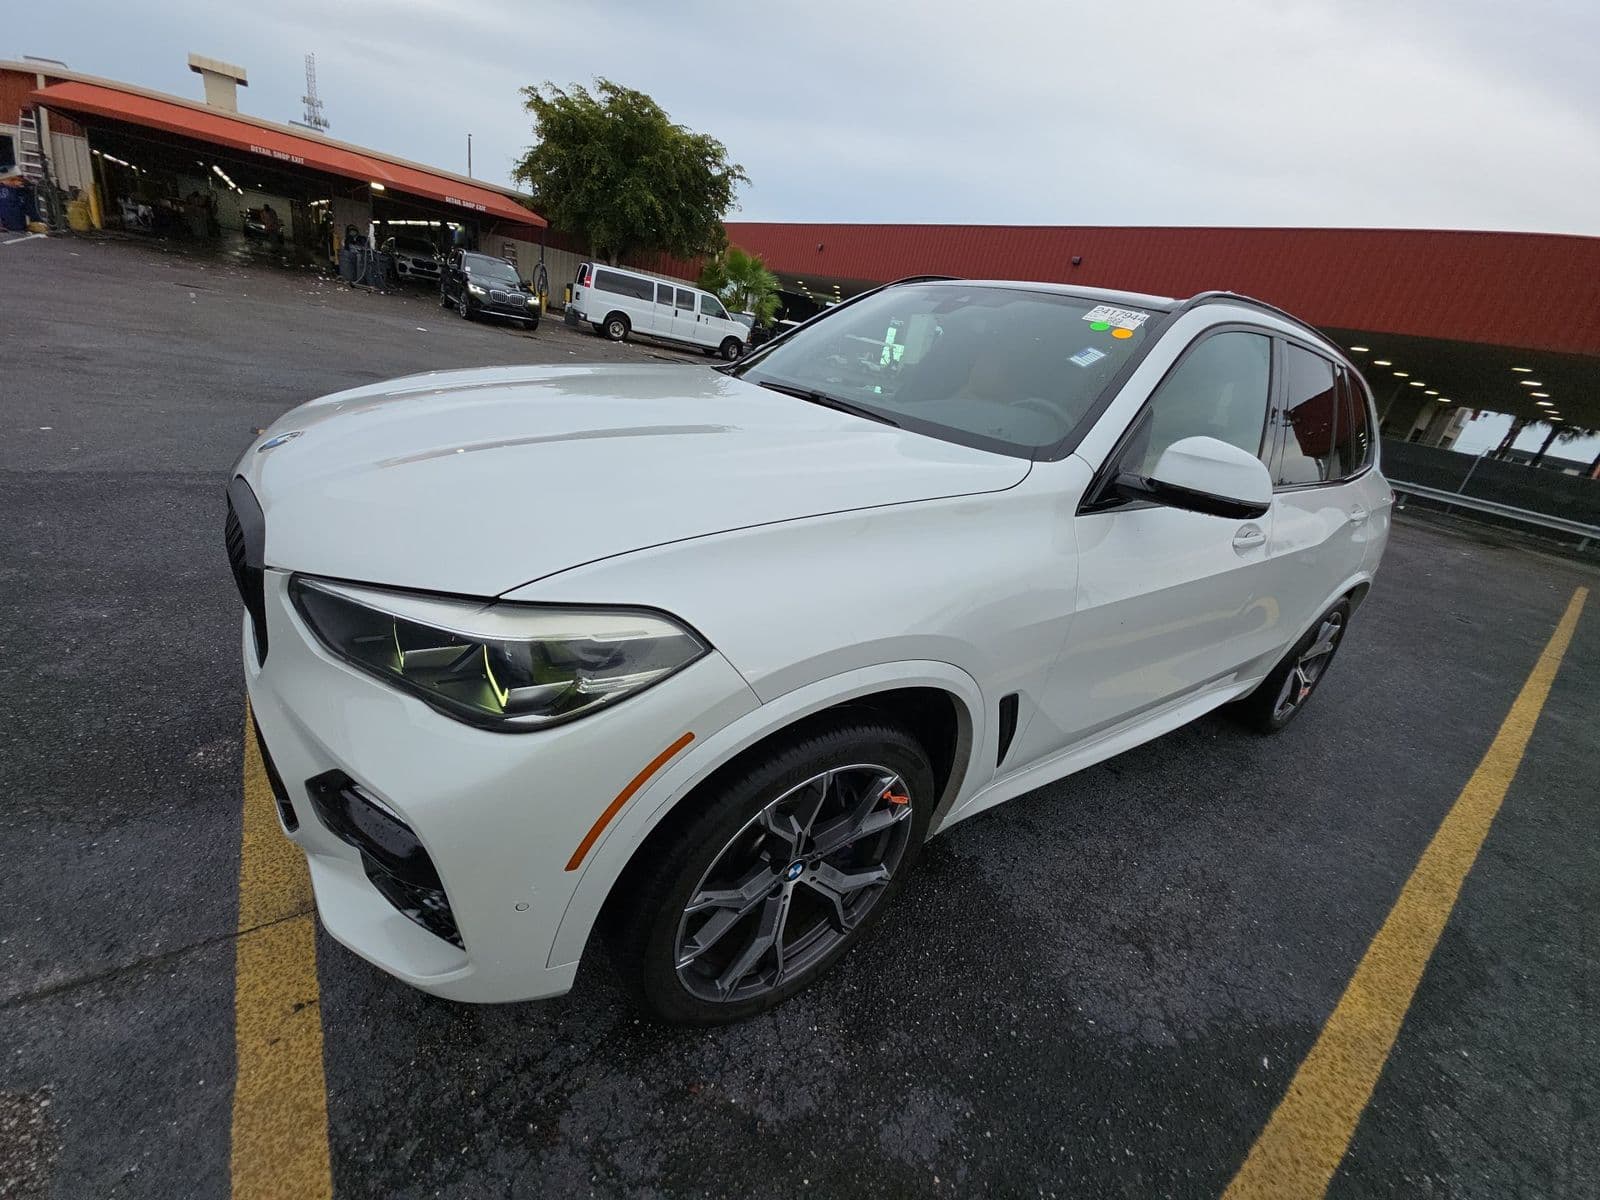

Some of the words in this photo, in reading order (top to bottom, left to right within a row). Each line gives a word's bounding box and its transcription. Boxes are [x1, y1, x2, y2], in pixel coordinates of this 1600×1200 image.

[250, 144, 272, 157] DETAIL
[273, 150, 290, 161] SHOP
[291, 155, 304, 165] EXIT
[445, 196, 461, 206] DETAIL
[462, 200, 475, 209] SHOP
[475, 204, 486, 212] EXIT
